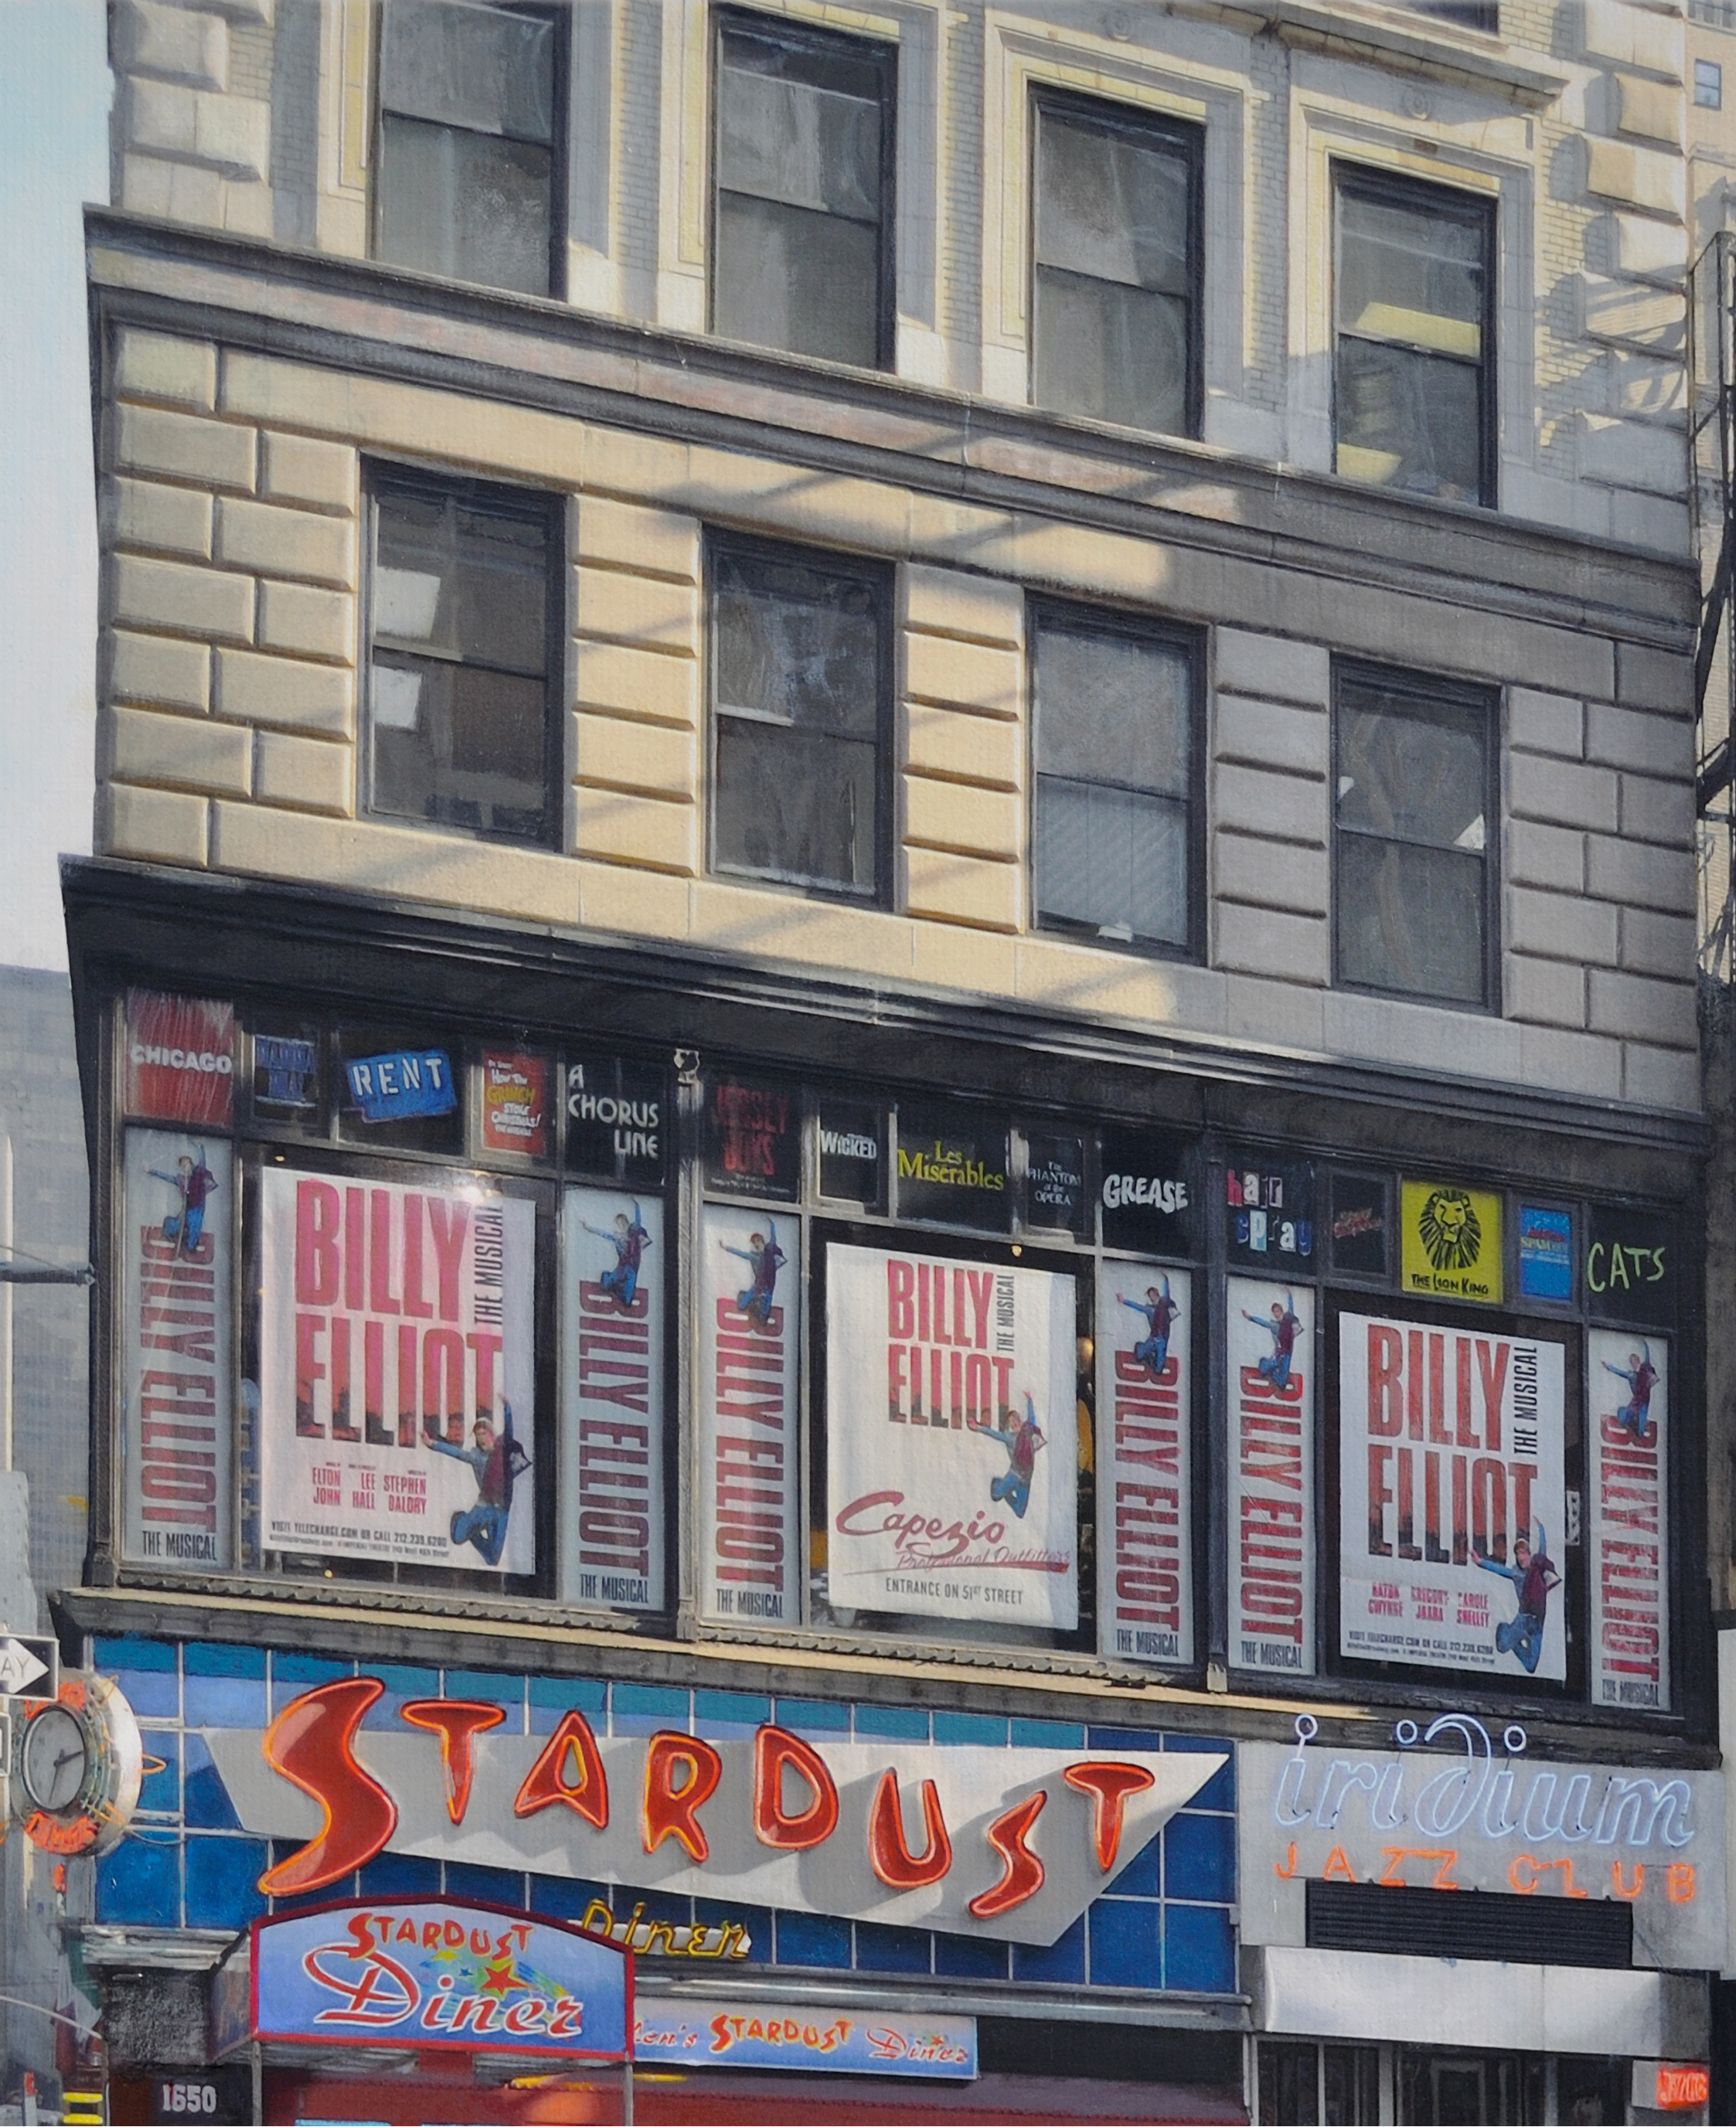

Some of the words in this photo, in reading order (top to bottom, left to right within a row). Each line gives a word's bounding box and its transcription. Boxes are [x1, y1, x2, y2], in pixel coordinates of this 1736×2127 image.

[130, 1044, 232, 1074] CHICAGO
[350, 1056, 445, 1096] RENT
[568, 1064, 584, 1089] A
[568, 1094, 659, 1128] CHORUS
[614, 1129, 659, 1159] LINE
[934, 1141, 963, 1165] Les
[1027, 1167, 1082, 1186] PHANTOM
[1035, 1190, 1072, 1205] OPERA
[1102, 1173, 1189, 1214] GREASE
[294, 1177, 472, 1322] BILLY
[474, 1203, 504, 1288] MUSICAL
[1587, 1242, 1666, 1293] CATS
[140, 1225, 216, 1363] BILLY
[474, 1294, 504, 1326] THE
[887, 1258, 995, 1349] BILLY
[996, 1274, 1015, 1328] MUSICAL
[579, 1280, 649, 1414] BILLY
[716, 1298, 785, 1431] BILLY
[996, 1331, 1015, 1353] THE
[295, 1312, 504, 1448] ELLIOT
[887, 1343, 1015, 1431] ELLIOT
[1367, 1323, 1511, 1451] BILLY
[1513, 1346, 1539, 1423] MUSICAL
[1115, 1349, 1180, 1475] BILLY
[1239, 1364, 1304, 1492] BILLY
[140, 1370, 217, 1533] ELLIOT
[1513, 1425, 1539, 1456] THE
[311, 1467, 341, 1487] ELTON
[312, 1486, 341, 1506] JOHN
[352, 1490, 376, 1510] HALL
[361, 1472, 376, 1491] LEE
[383, 1475, 427, 1495] STEPHEN
[579, 1418, 649, 1577] ELLIOT
[1600, 1413, 1659, 1536] BILLY
[716, 1434, 785, 1593] ELLIOT
[836, 1490, 1005, 1560] Capezio
[1367, 1443, 1539, 1567] ELLIOT
[142, 1530, 162, 1557] THE
[166, 1532, 217, 1561] MUSICAL
[373, 1531, 392, 1543] CALL
[1115, 1481, 1180, 1632] ELLIOT
[580, 1573, 597, 1599] THE
[601, 1576, 649, 1605] MUSICAL
[885, 1577, 941, 1598] ENTRANCE
[945, 1583, 960, 1599] ON
[984, 1587, 1024, 1605] STREET
[1239, 1496, 1304, 1645] ELLIOT
[716, 1588, 734, 1613] THE
[737, 1590, 785, 1618] MUSICAL
[1601, 1539, 1660, 1683] ELLIOT
[1116, 1628, 1133, 1653] THE
[1136, 1630, 1179, 1658] MUSICAL
[1241, 1640, 1257, 1665] THE
[1260, 1642, 1303, 1669] MUSICAL
[257, 1676, 1156, 1919] STARDUST
[1273, 1712, 1697, 1847] iridium
[1275, 1842, 1459, 1891] JAZZ
[1508, 1854, 1697, 1904] CLUB
[347, 1912, 533, 1962] STARDUST
[581, 1898, 750, 1959] Diner
[301, 1941, 584, 2038] Diner
[710, 2013, 853, 2054] STARDUST
[866, 2027, 970, 2064] Diner
[162, 2083, 217, 2114] 1650
